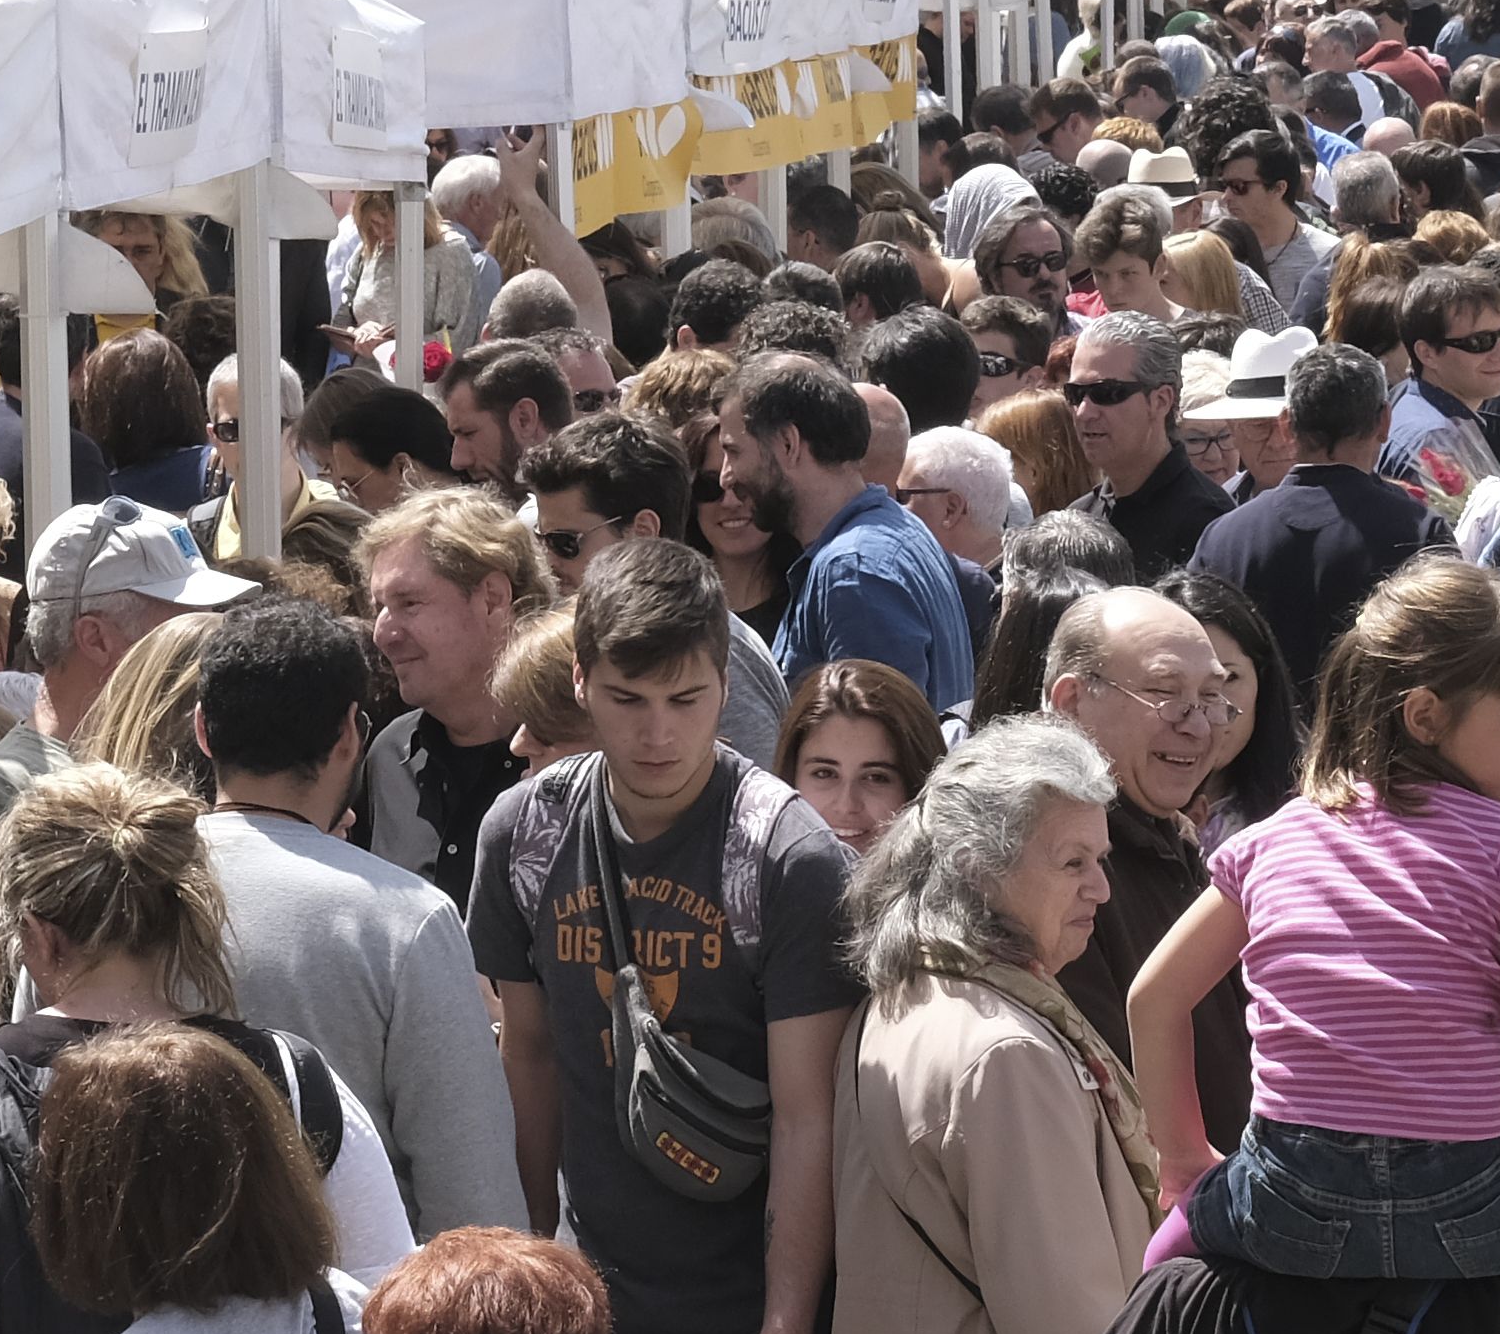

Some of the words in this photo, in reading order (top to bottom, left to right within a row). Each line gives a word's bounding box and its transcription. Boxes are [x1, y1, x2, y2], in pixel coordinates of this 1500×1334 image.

[553, 885, 601, 920] LAKE
[672, 884, 727, 934] TRACK
[702, 932, 722, 969] 9
